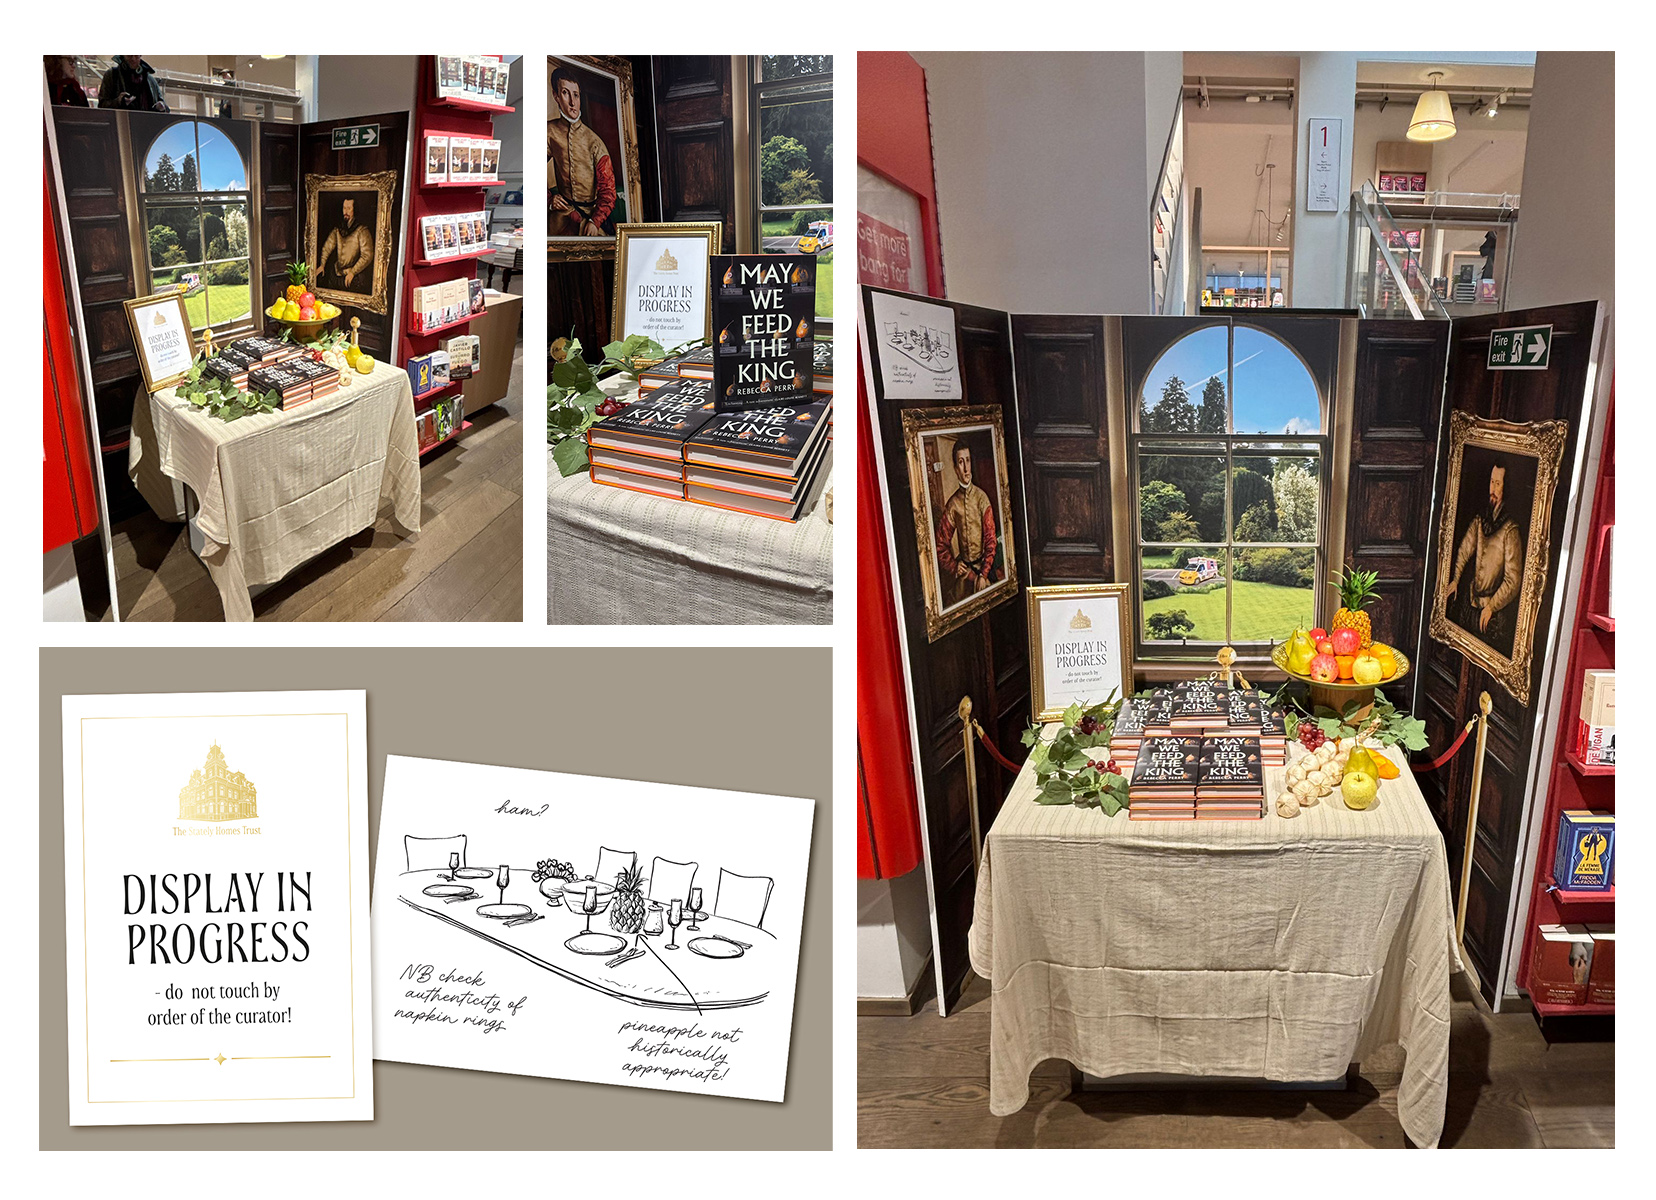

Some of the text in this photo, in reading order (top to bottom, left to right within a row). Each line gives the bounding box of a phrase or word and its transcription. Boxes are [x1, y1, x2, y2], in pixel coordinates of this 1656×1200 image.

[1320, 126, 1328, 147] 1
[857, 217, 907, 257] Get more
[739, 262, 794, 285] MAY
[859, 248, 906, 283] bang for
[639, 284, 693, 298] DISPLAY IN
[750, 288, 784, 310] WE
[639, 299, 692, 313] PROGRESS
[742, 313, 793, 335] FEED
[148, 331, 172, 345] DISPLAY
[150, 338, 180, 354] PROGRESS
[1493, 334, 1509, 346] Fire
[745, 337, 789, 359] THE
[1491, 350, 1506, 362] exit
[738, 360, 795, 383] KING
[679, 387, 710, 397] WE
[681, 379, 713, 389] MA
[737, 383, 797, 396] REBECCA PERRY
[652, 401, 694, 414] THE
[656, 393, 706, 406] FEED
[616, 418, 650, 428] REBECCA
[626, 408, 687, 424] KING
[742, 412, 788, 426] THE
[720, 420, 786, 438] KING
[712, 431, 750, 440] REBECCA
[753, 436, 779, 444] PERRY
[1054, 640, 1108, 655] DISPLAY IN
[1056, 653, 1108, 669] PROGRESS
[1214, 737, 1246, 745] MAY
[1591, 727, 1604, 764] DE VIGAN
[1151, 752, 1185, 760] FEED
[1213, 752, 1246, 760] FEED
[1145, 767, 1185, 776] KING
[1210, 767, 1249, 776] KING
[494, 799, 550, 817] ham?
[172, 825, 262, 838] The Stately Homes Trust
[123, 871, 312, 915] DISPLAY IN
[128, 921, 310, 965] PROGRESS
[399, 963, 486, 987] NB check
[165, 983, 184, 1000] do
[191, 985, 216, 1000] not
[219, 981, 260, 1000] touch
[263, 981, 281, 1002] by
[404, 986, 528, 1016] authenticity of
[147, 1007, 292, 1026] order of the curator!
[394, 1007, 507, 1035] napkin rings
[617, 1020, 744, 1043] pineapple not
[627, 1037, 729, 1067] historically
[621, 1062, 731, 1083] appropriate!
